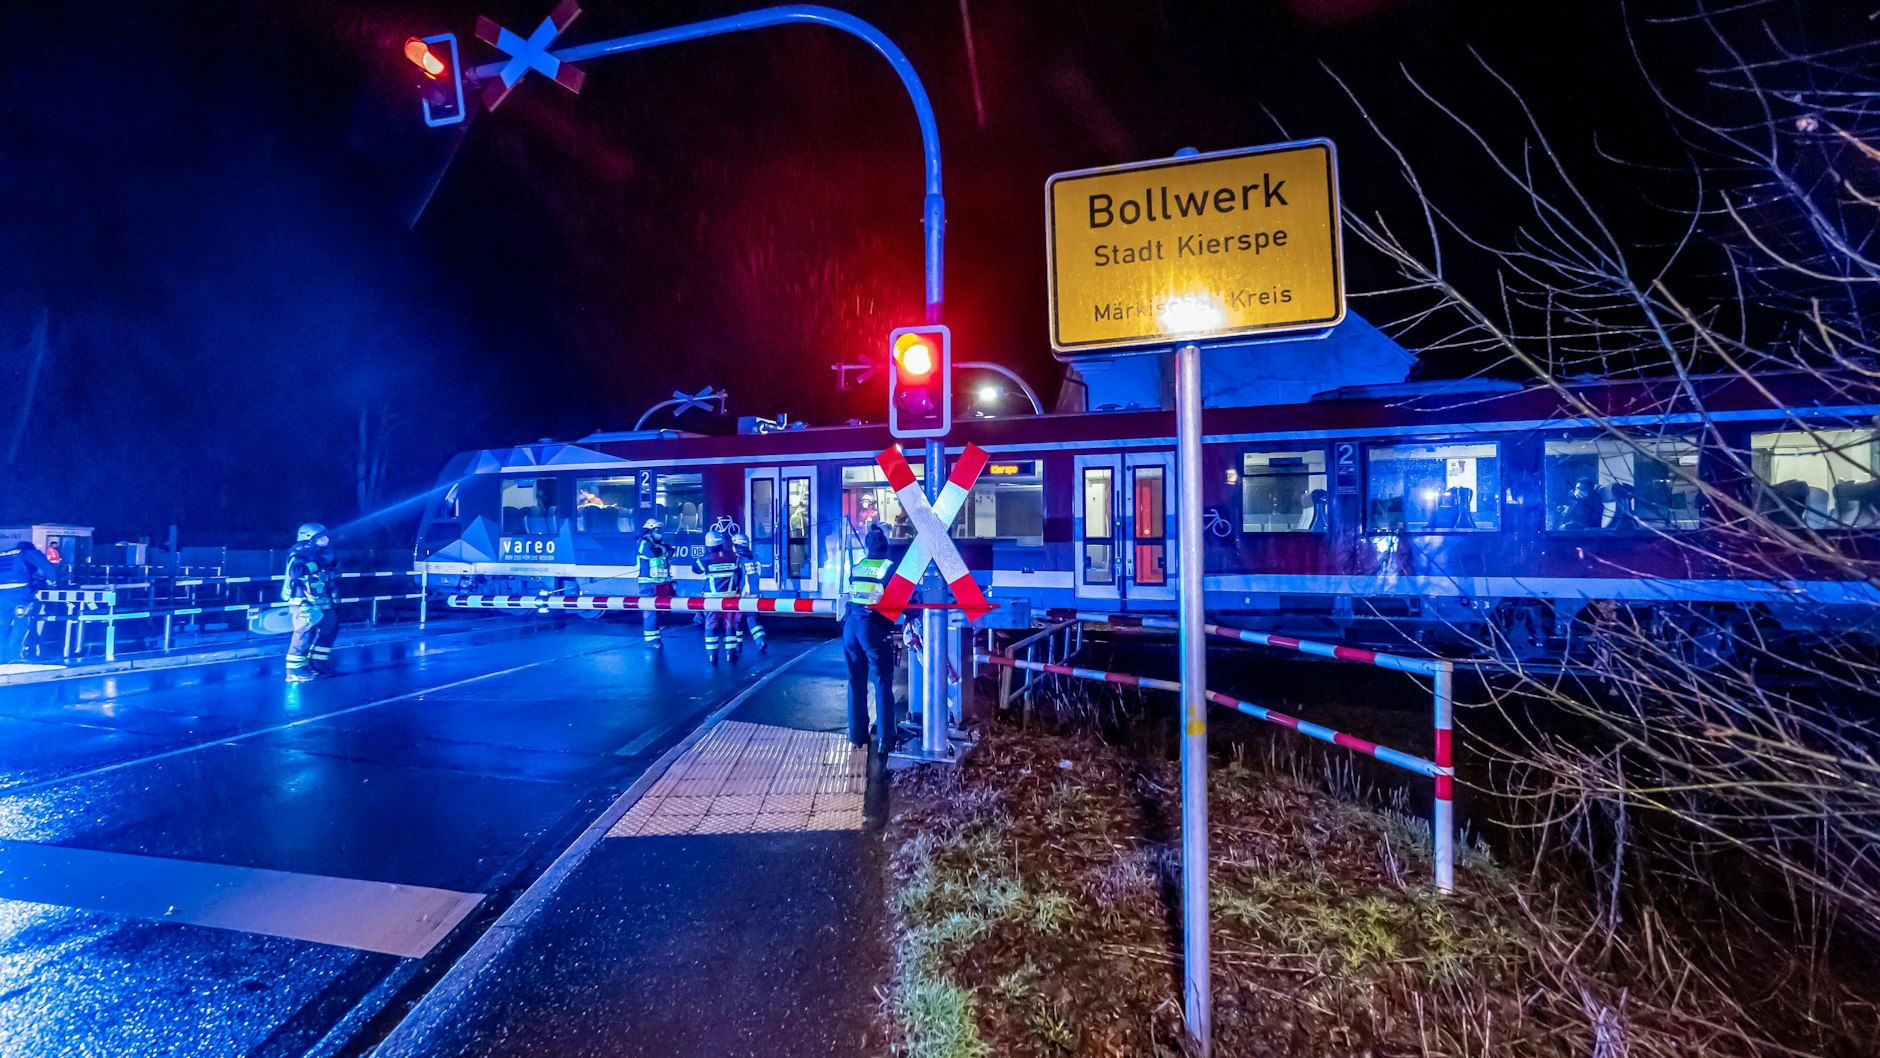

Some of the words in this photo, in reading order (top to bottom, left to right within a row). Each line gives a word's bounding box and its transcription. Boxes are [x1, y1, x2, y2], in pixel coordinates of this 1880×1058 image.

[1088, 173, 1289, 229] Bollwerk
[1094, 239, 1164, 268] Stadt
[1178, 229, 1288, 258] Kierspe
[1231, 285, 1292, 309] Kreis
[1339, 444, 1353, 465] 2
[641, 471, 650, 486] 2
[503, 540, 556, 554] vareo
[692, 546, 704, 557] DB
